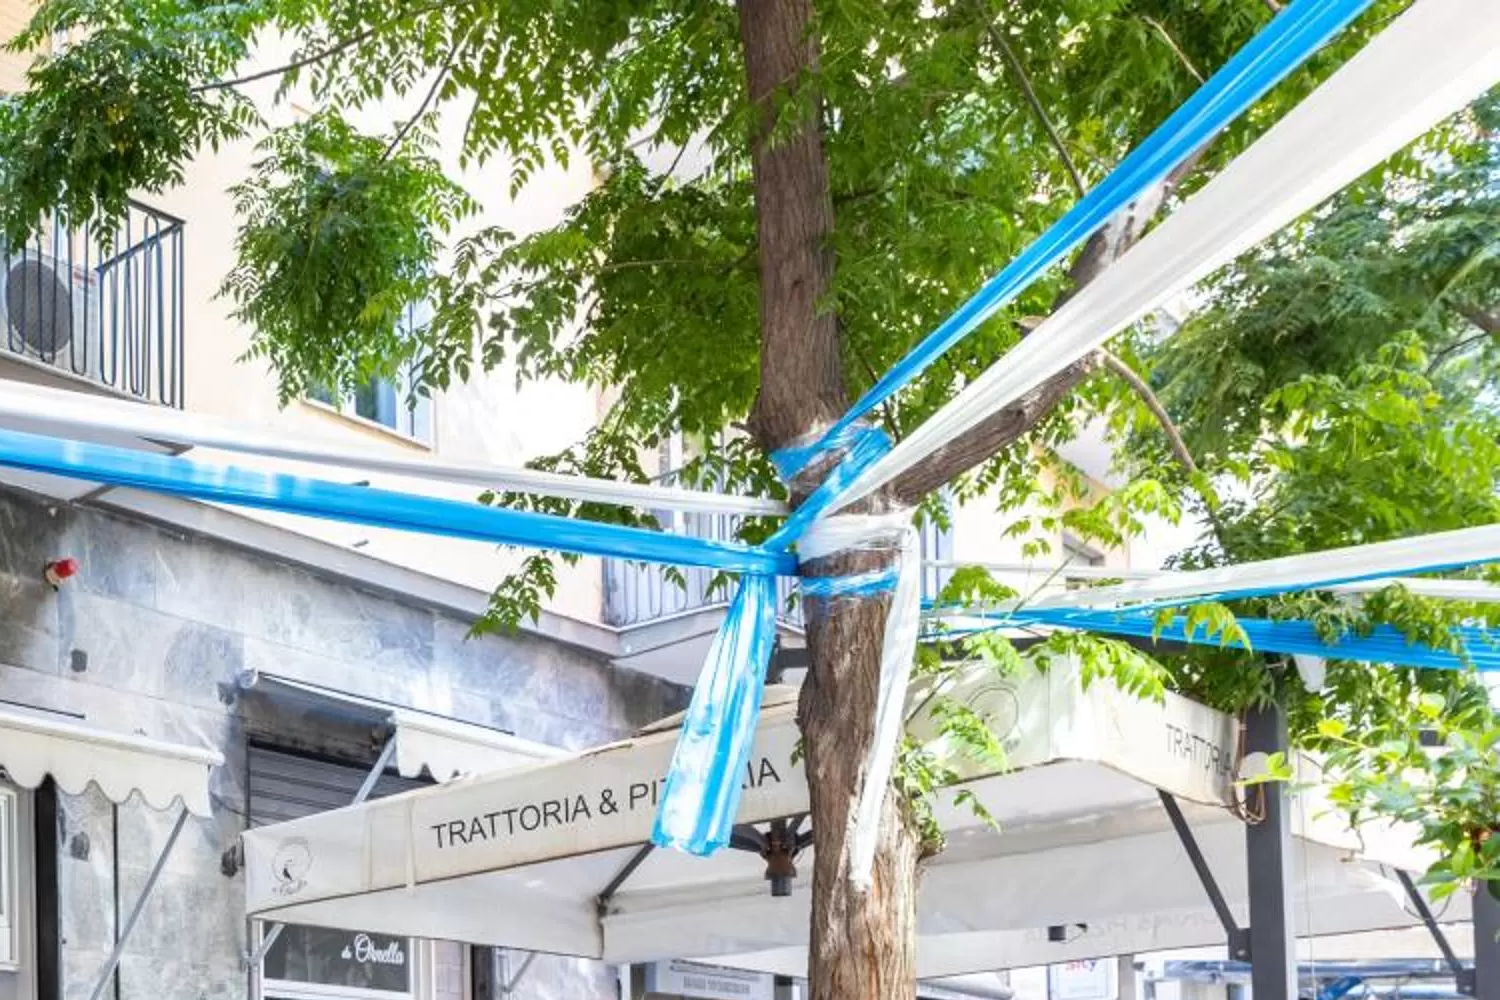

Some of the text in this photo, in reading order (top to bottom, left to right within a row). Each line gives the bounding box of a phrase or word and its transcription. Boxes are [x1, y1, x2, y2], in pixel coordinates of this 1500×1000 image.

[430, 756, 781, 849] TRATTORIA & PIIA
[353, 933, 405, 966] Ornella
